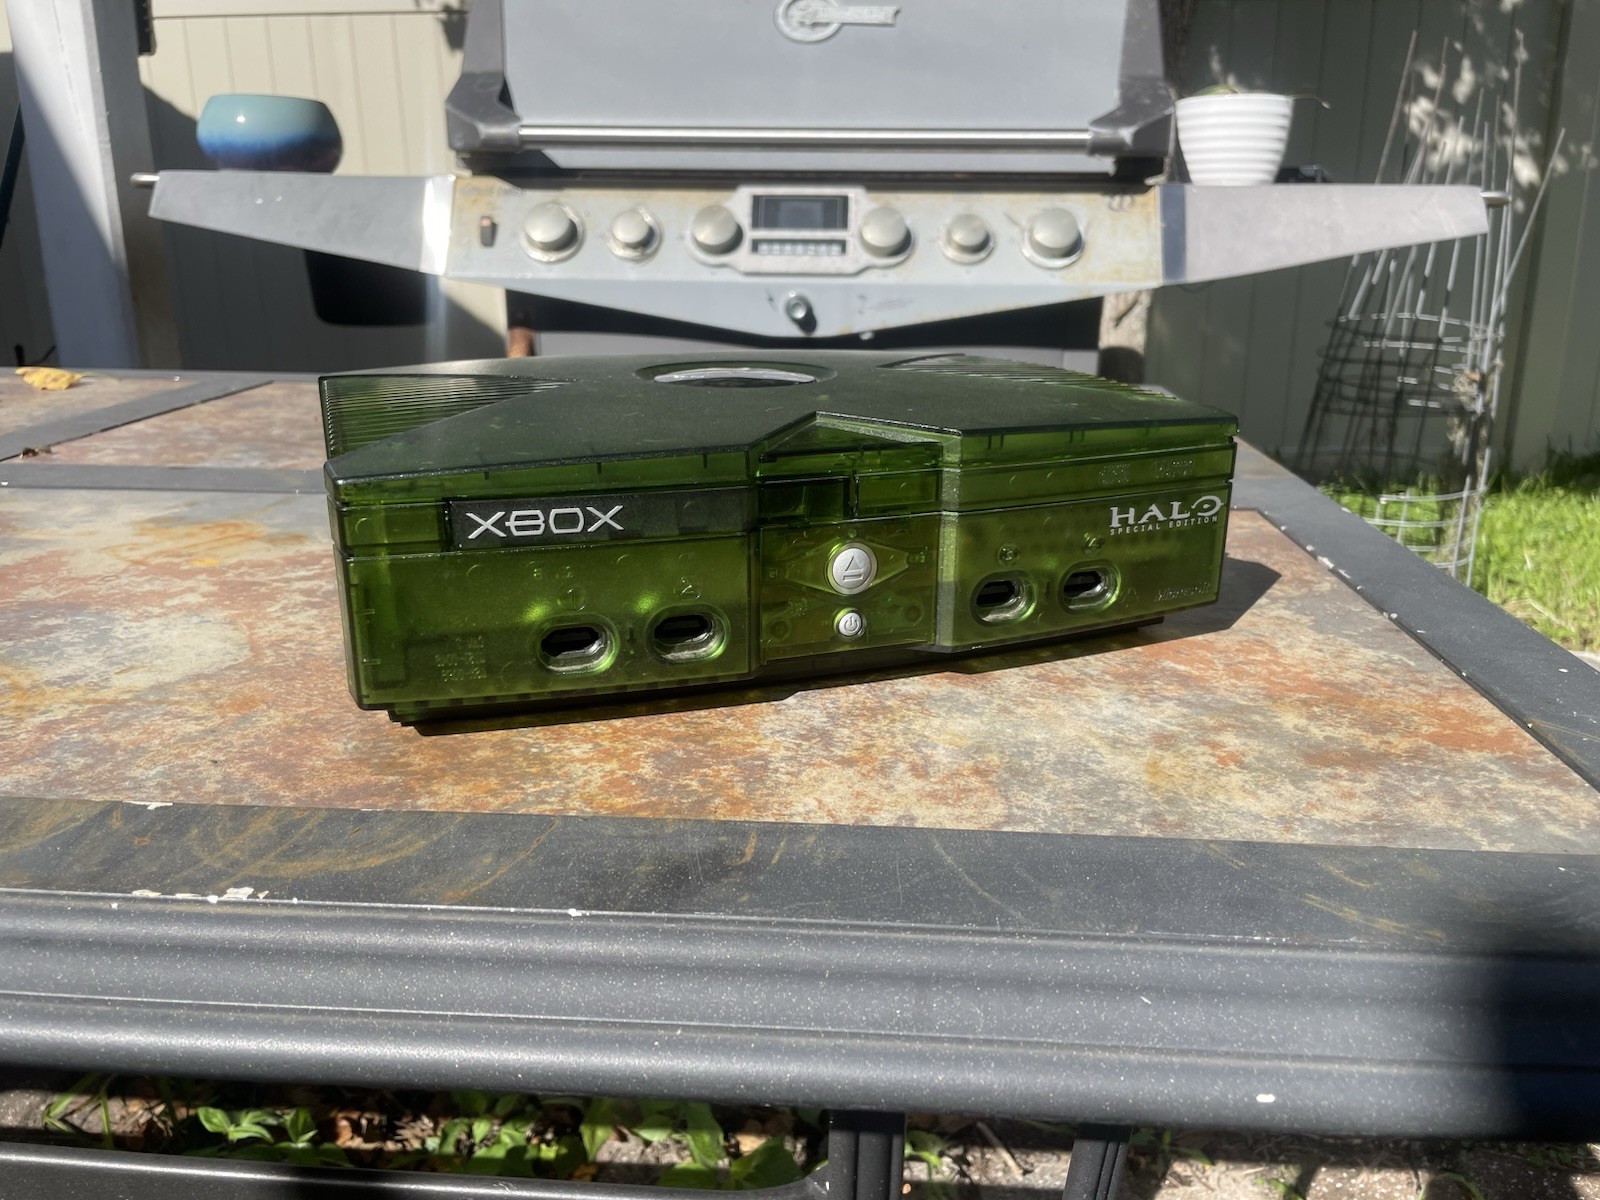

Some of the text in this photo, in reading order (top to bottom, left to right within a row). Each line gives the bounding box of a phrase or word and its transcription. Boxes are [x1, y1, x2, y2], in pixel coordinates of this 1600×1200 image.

[466, 505, 625, 539] XBOX
[1110, 495, 1224, 528] HALO
[1110, 515, 1218, 536] SPECIAL EDITION
